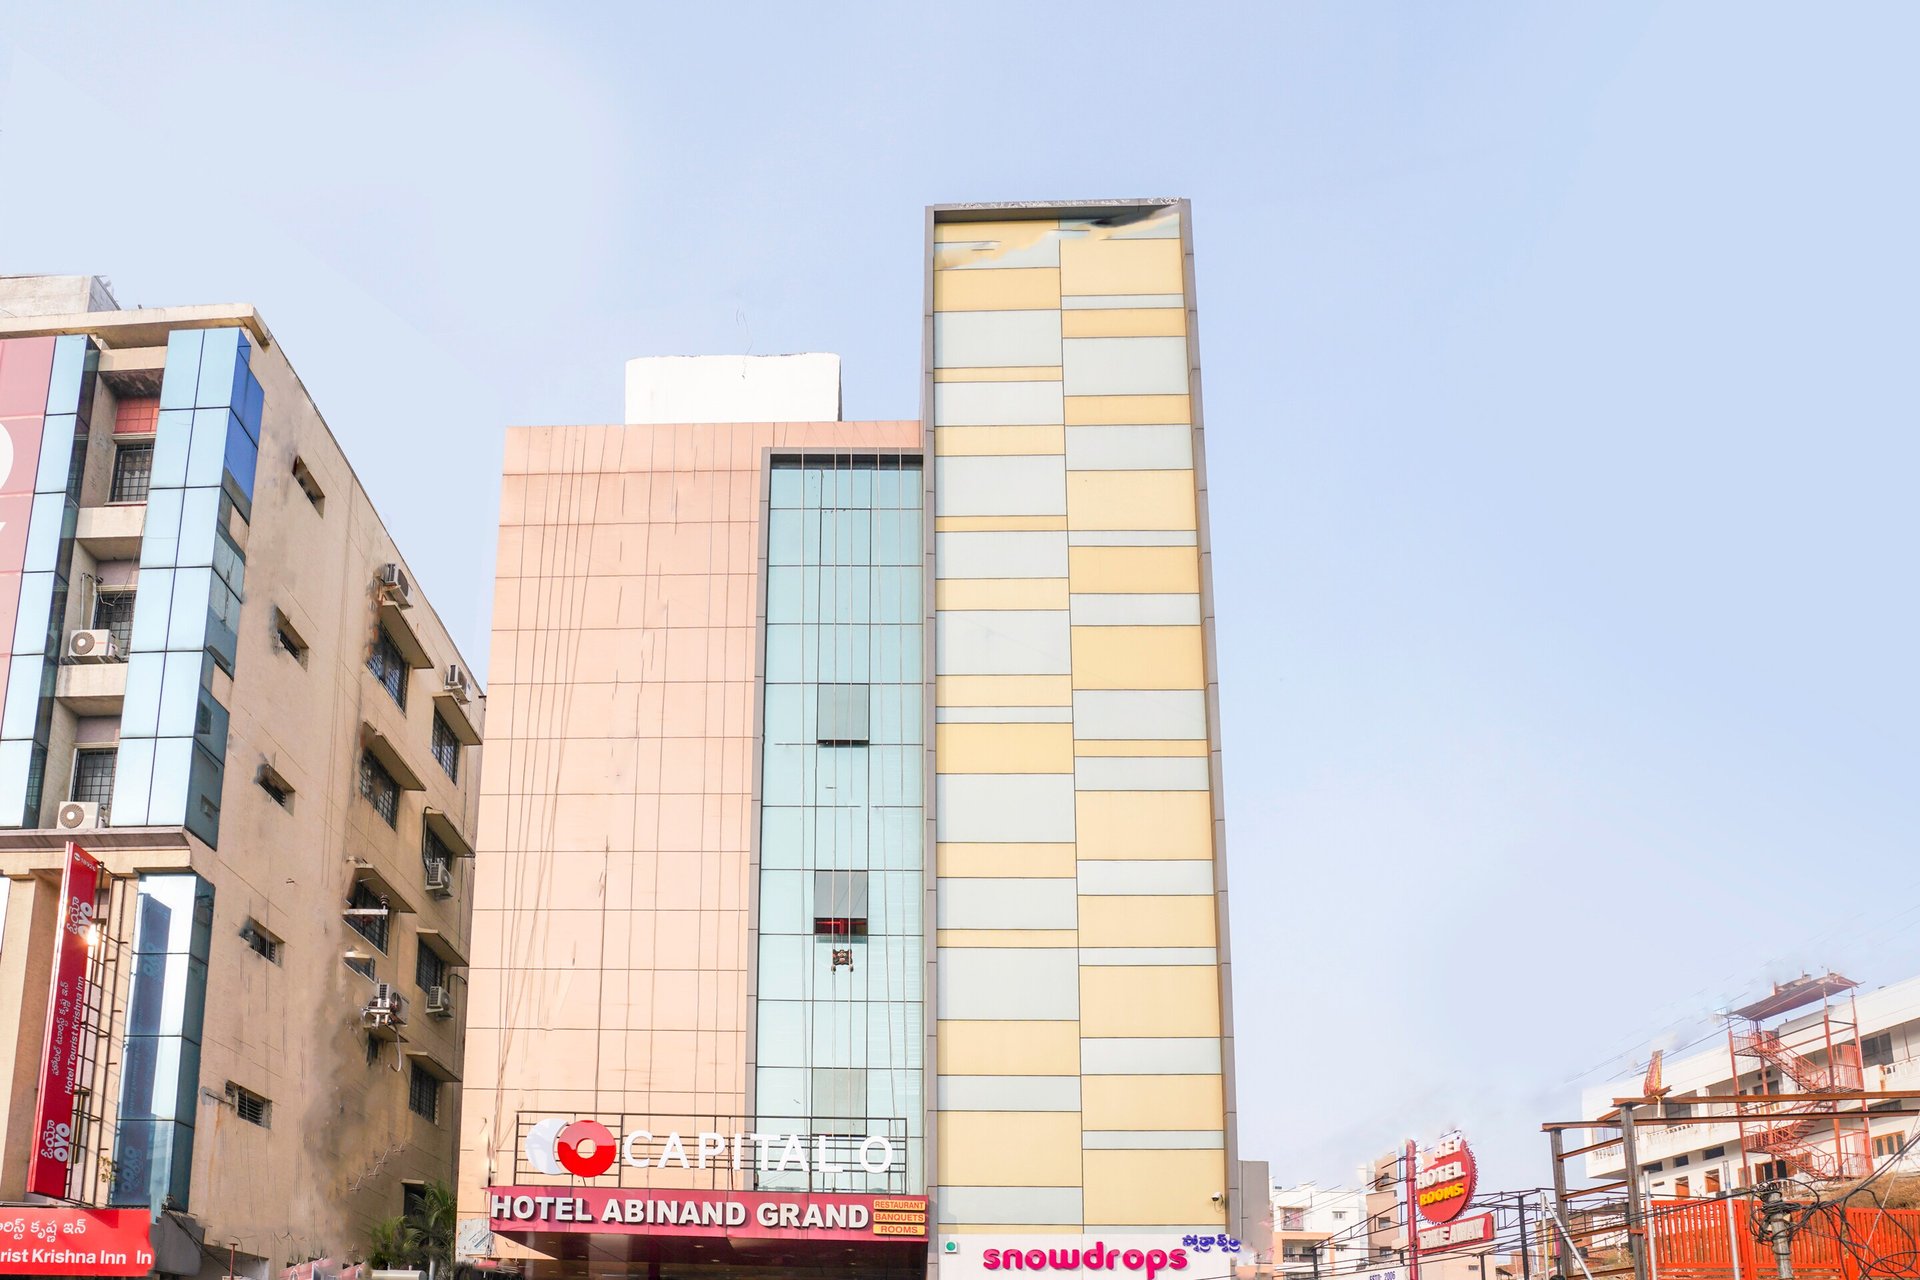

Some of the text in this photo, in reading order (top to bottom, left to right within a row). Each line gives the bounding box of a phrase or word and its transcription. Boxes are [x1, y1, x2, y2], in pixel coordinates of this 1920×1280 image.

[78, 902, 93, 938] OYO
[64, 976, 84, 1095] Hotel Tourist Krishna Inn
[53, 1123, 71, 1162] OYO
[623, 1130, 893, 1174] CAPITAL O
[1416, 1161, 1466, 1190] HOTEL
[875, 1201, 924, 1209] RESTAURANT
[1420, 1183, 1465, 1206] ROOMS
[491, 1195, 869, 1229] HOTEL ABINAND GRAND
[875, 1213, 924, 1222] BANQUETS
[0, 1218, 86, 1242] రిస్ట్ కృష్ణ ఇన్
[880, 1225, 918, 1234] ROOMS
[32, 1249, 96, 1264] Krishna
[100, 1250, 126, 1264] Inn
[983, 1241, 1188, 1280] snowdrops
